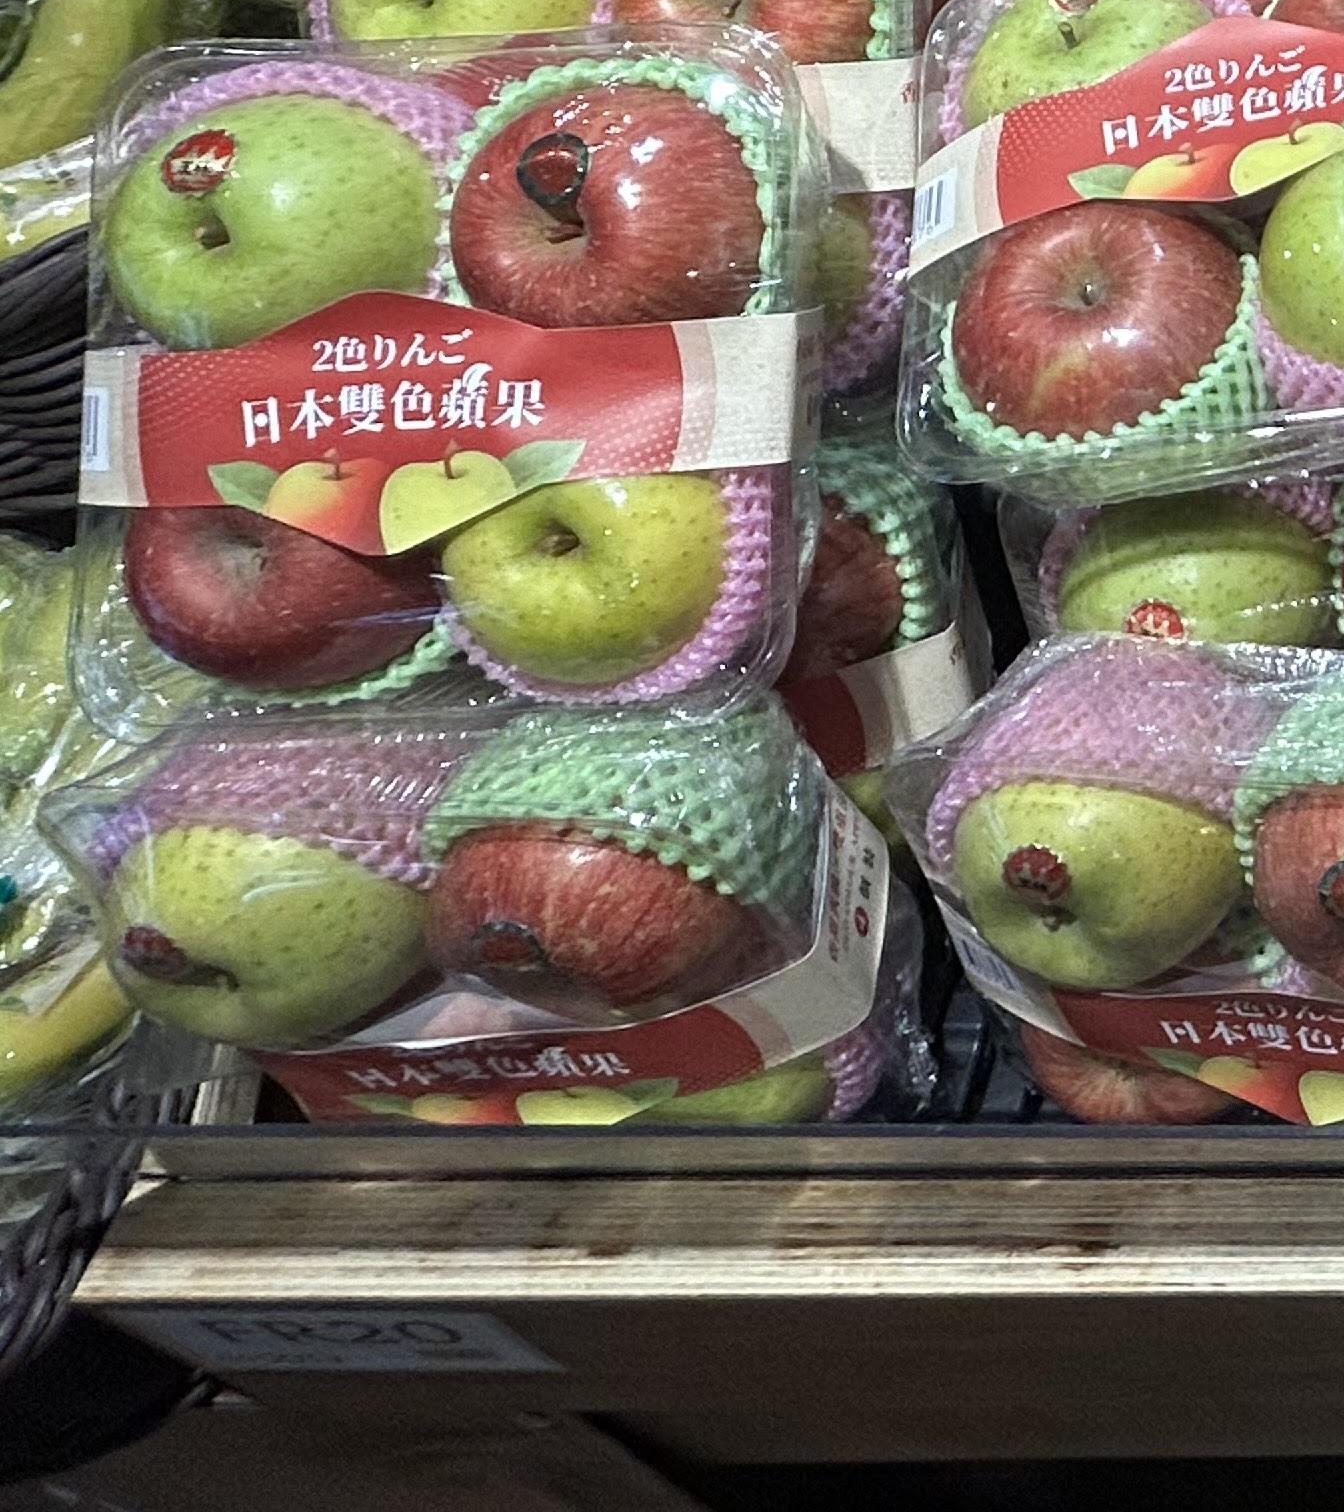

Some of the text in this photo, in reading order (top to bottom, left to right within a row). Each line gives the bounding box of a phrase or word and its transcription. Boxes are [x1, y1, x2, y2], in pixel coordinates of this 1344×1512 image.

[1164, 46, 1304, 91] 2色りんご
[312, 330, 473, 373] 2色りんご
[243, 363, 545, 447] 日本雙色蘋果
